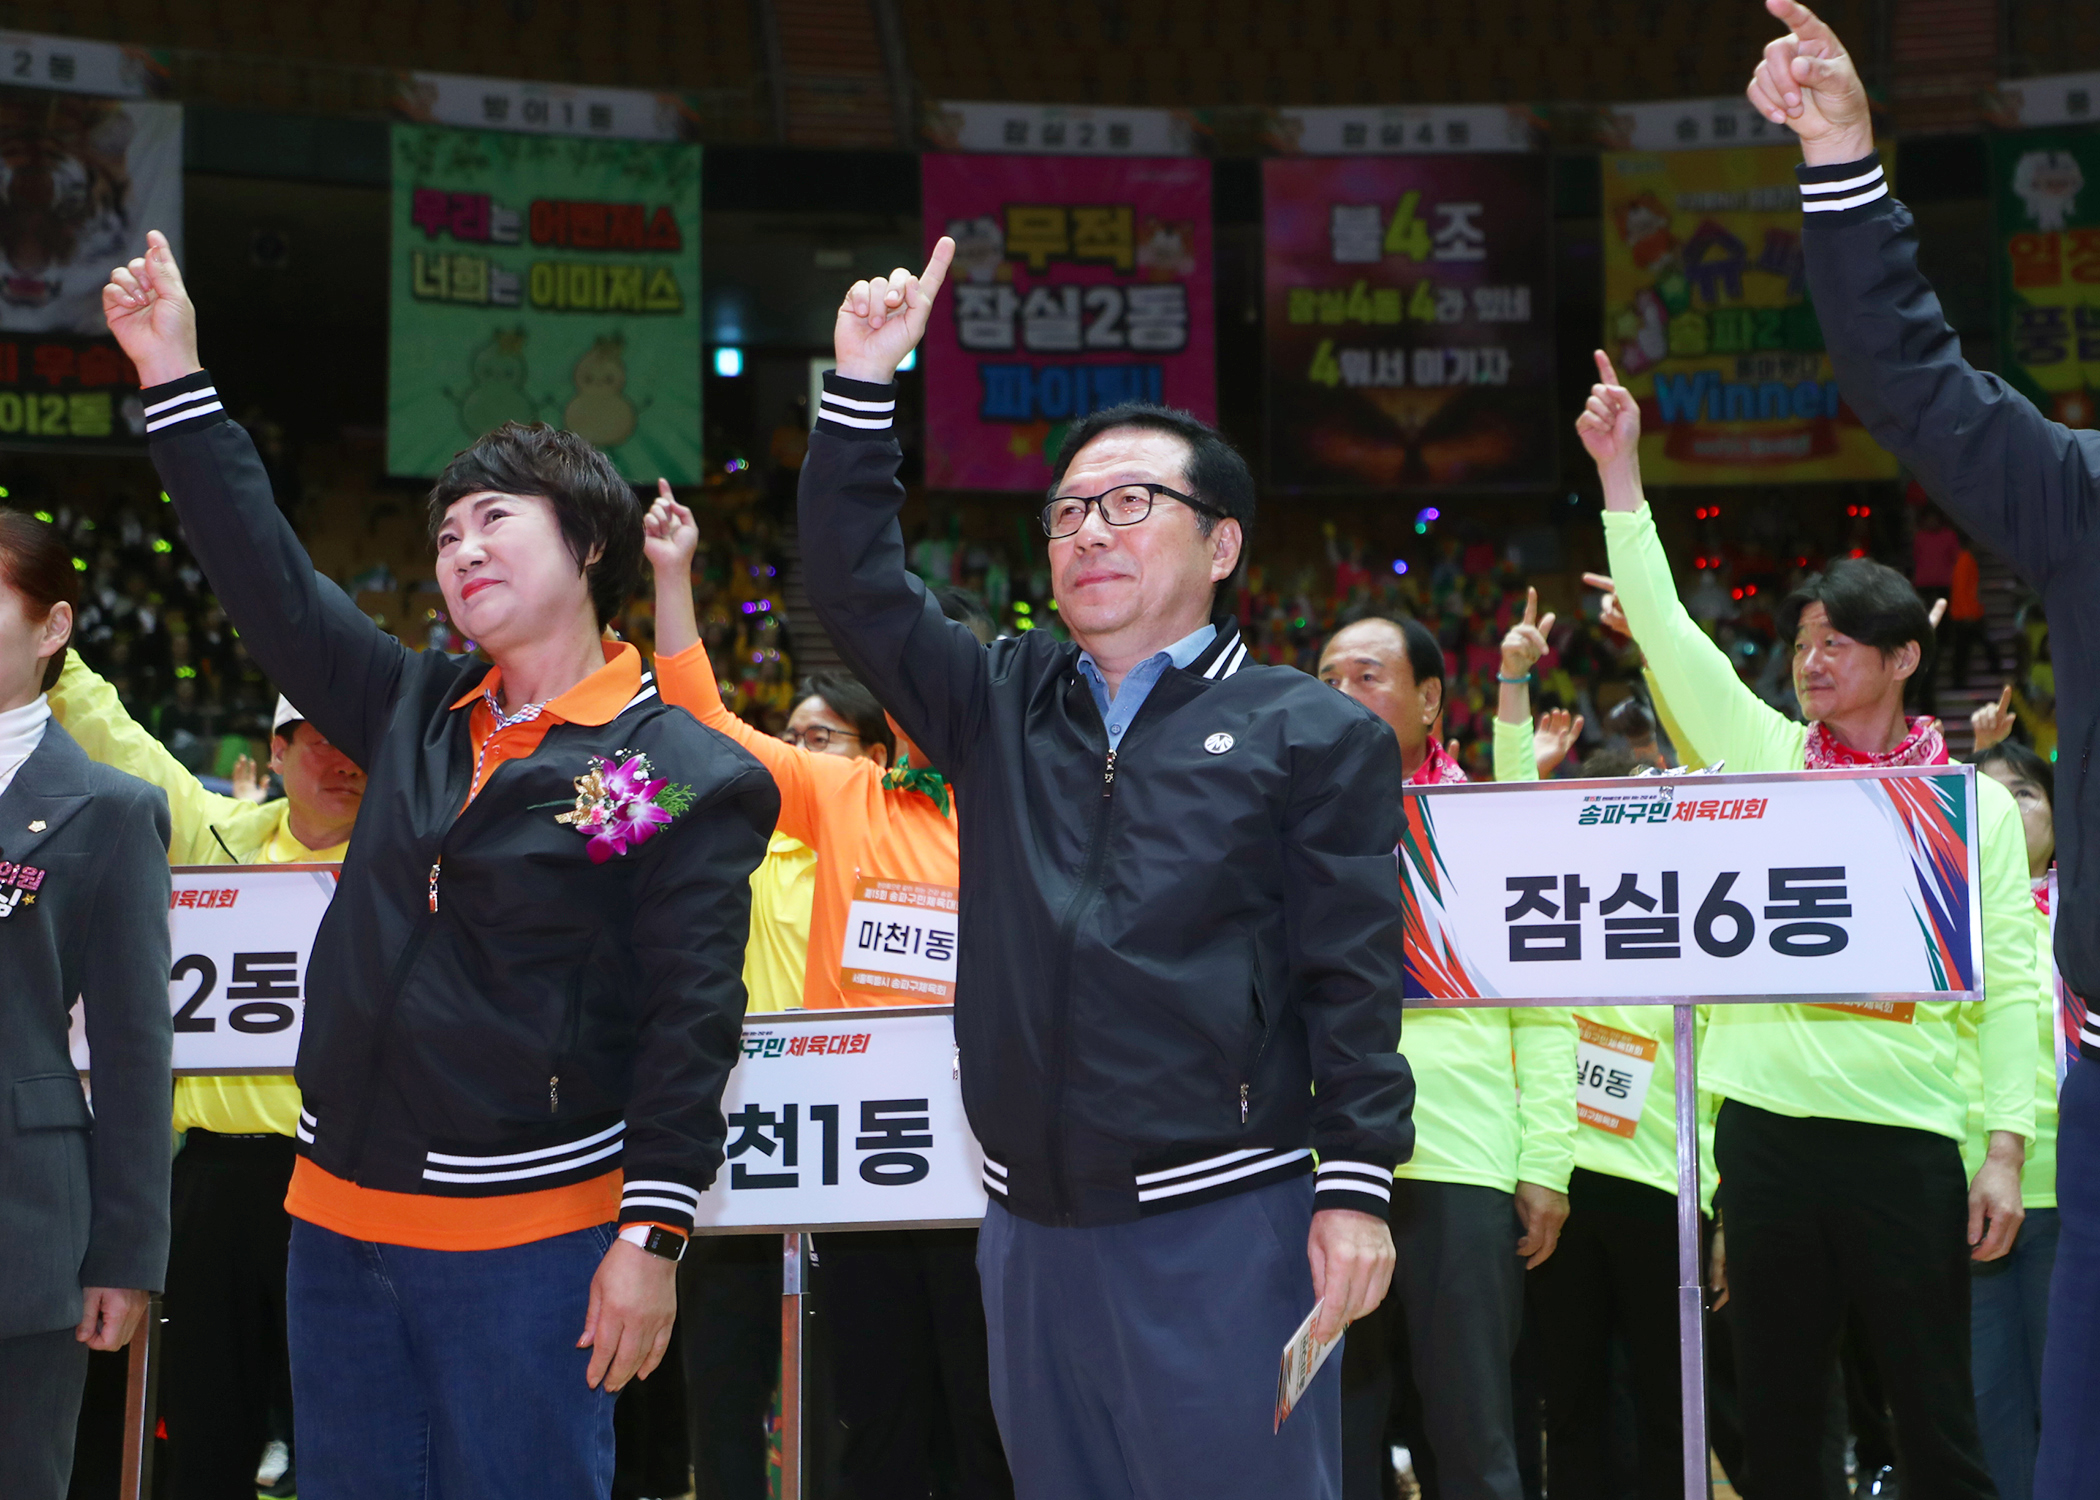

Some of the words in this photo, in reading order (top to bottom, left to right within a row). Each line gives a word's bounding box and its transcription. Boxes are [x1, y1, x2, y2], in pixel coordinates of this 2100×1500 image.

[412, 187, 520, 243] 우리는
[1005, 206, 1135, 274] 무적
[412, 250, 520, 305] 너희는
[954, 284, 1188, 351] 잠실2동
[1578, 802, 1673, 825] 송파구민
[1671, 797, 1769, 822] 체육대회
[864, 887, 888, 901] 제15회
[889, 891, 959, 911] 송파구민체육대
[1504, 865, 1853, 962] 잠실6동
[858, 919, 956, 962] 마천1동
[170, 951, 300, 1035] 2동
[740, 1037, 786, 1058] 구민
[785, 1033, 872, 1056] 체육대회
[727, 1098, 934, 1190] 천1동
